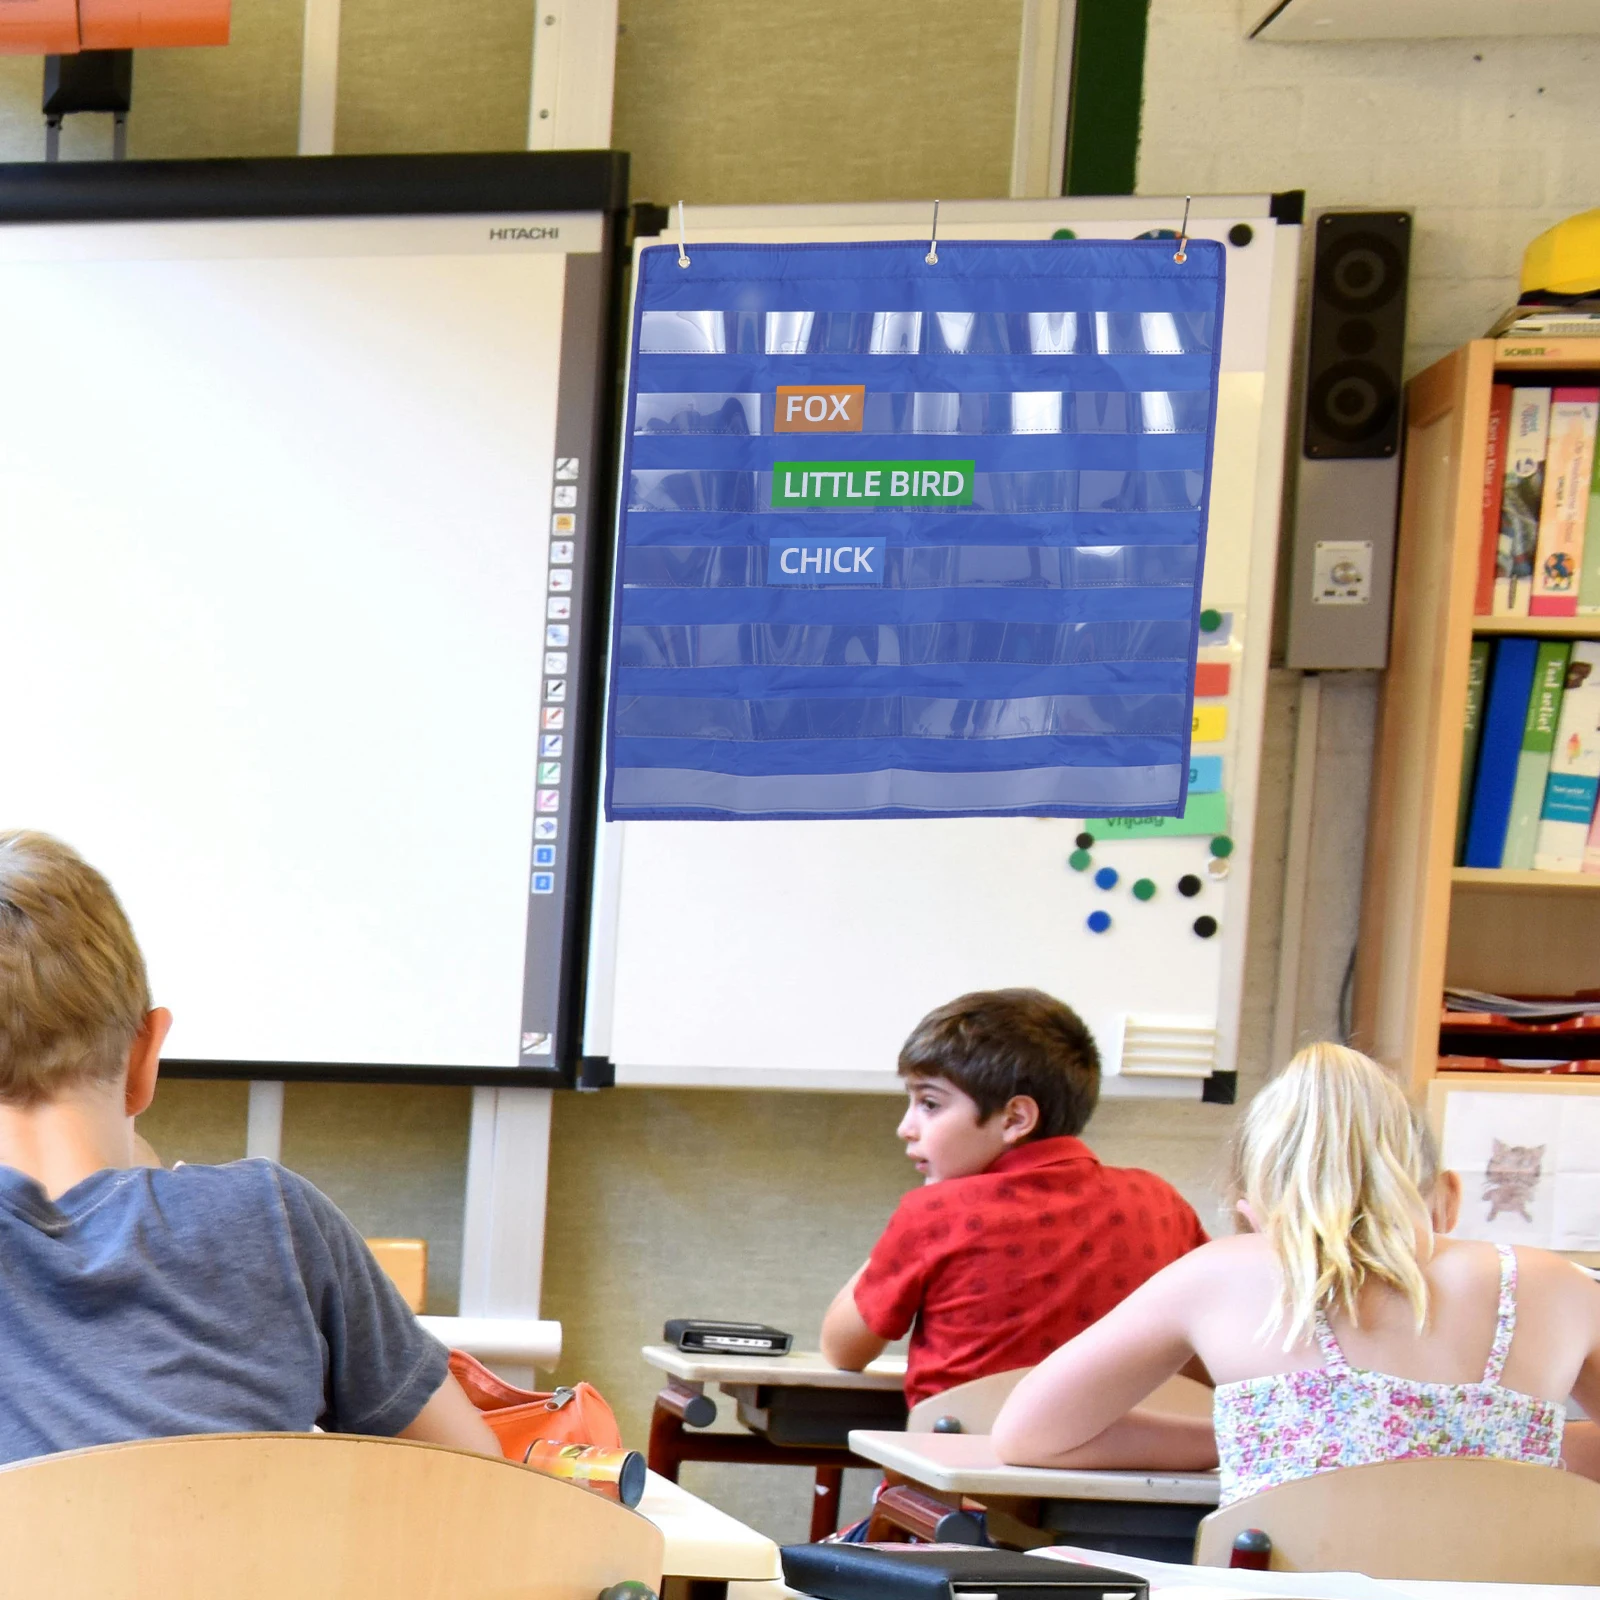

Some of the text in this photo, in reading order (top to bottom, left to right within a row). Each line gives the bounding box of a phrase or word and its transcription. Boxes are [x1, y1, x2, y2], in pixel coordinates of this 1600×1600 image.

[489, 227, 559, 240] HITACHI
[786, 394, 852, 422] FOX
[784, 470, 965, 498] LITTLE BIRD
[780, 546, 875, 574] CHICK
[1544, 660, 1563, 688] Taal
